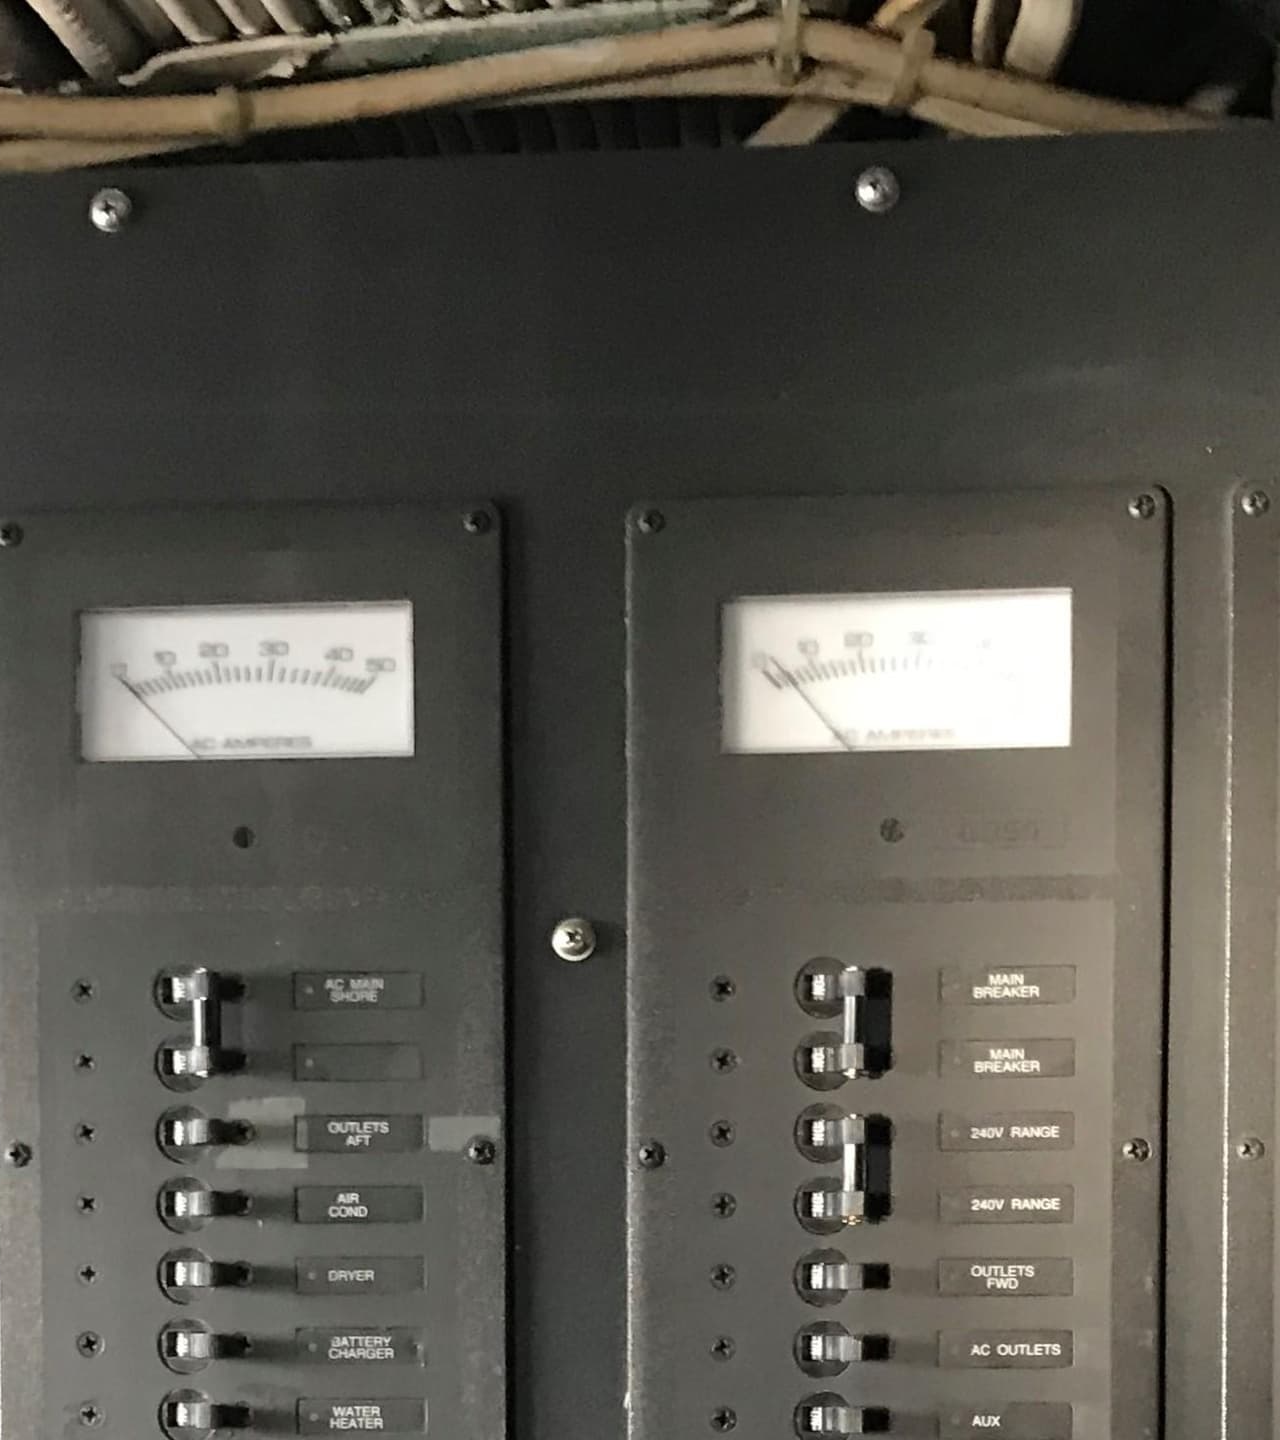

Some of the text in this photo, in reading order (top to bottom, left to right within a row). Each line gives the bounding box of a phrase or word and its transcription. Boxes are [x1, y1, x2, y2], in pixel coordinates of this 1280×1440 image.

[325, 979, 384, 990] AC MAIN
[987, 974, 1025, 986] MAIN
[331, 991, 377, 1002] SHORE
[974, 986, 1039, 999] BREAKER
[989, 1049, 1025, 1060] MAIN
[975, 1061, 1040, 1073] BREAKER
[328, 1122, 389, 1134] OUTLETS
[971, 1126, 1059, 1139] 240V RANGE
[346, 1135, 371, 1146] AFT
[338, 1194, 359, 1204] AIR
[972, 1199, 1060, 1211] 240V RANGE
[329, 1206, 368, 1217] COND
[329, 1270, 374, 1281] DRYER
[971, 1265, 1034, 1277] OUTLETS
[986, 1278, 1018, 1289] FWD
[331, 1336, 392, 1347] BATTERY
[329, 1347, 394, 1359] CHARGER
[971, 1344, 1061, 1356] AC OUTLETS
[333, 1406, 381, 1417] WATER
[330, 1418, 383, 1429] HEATER
[972, 1416, 1000, 1427] AUX
